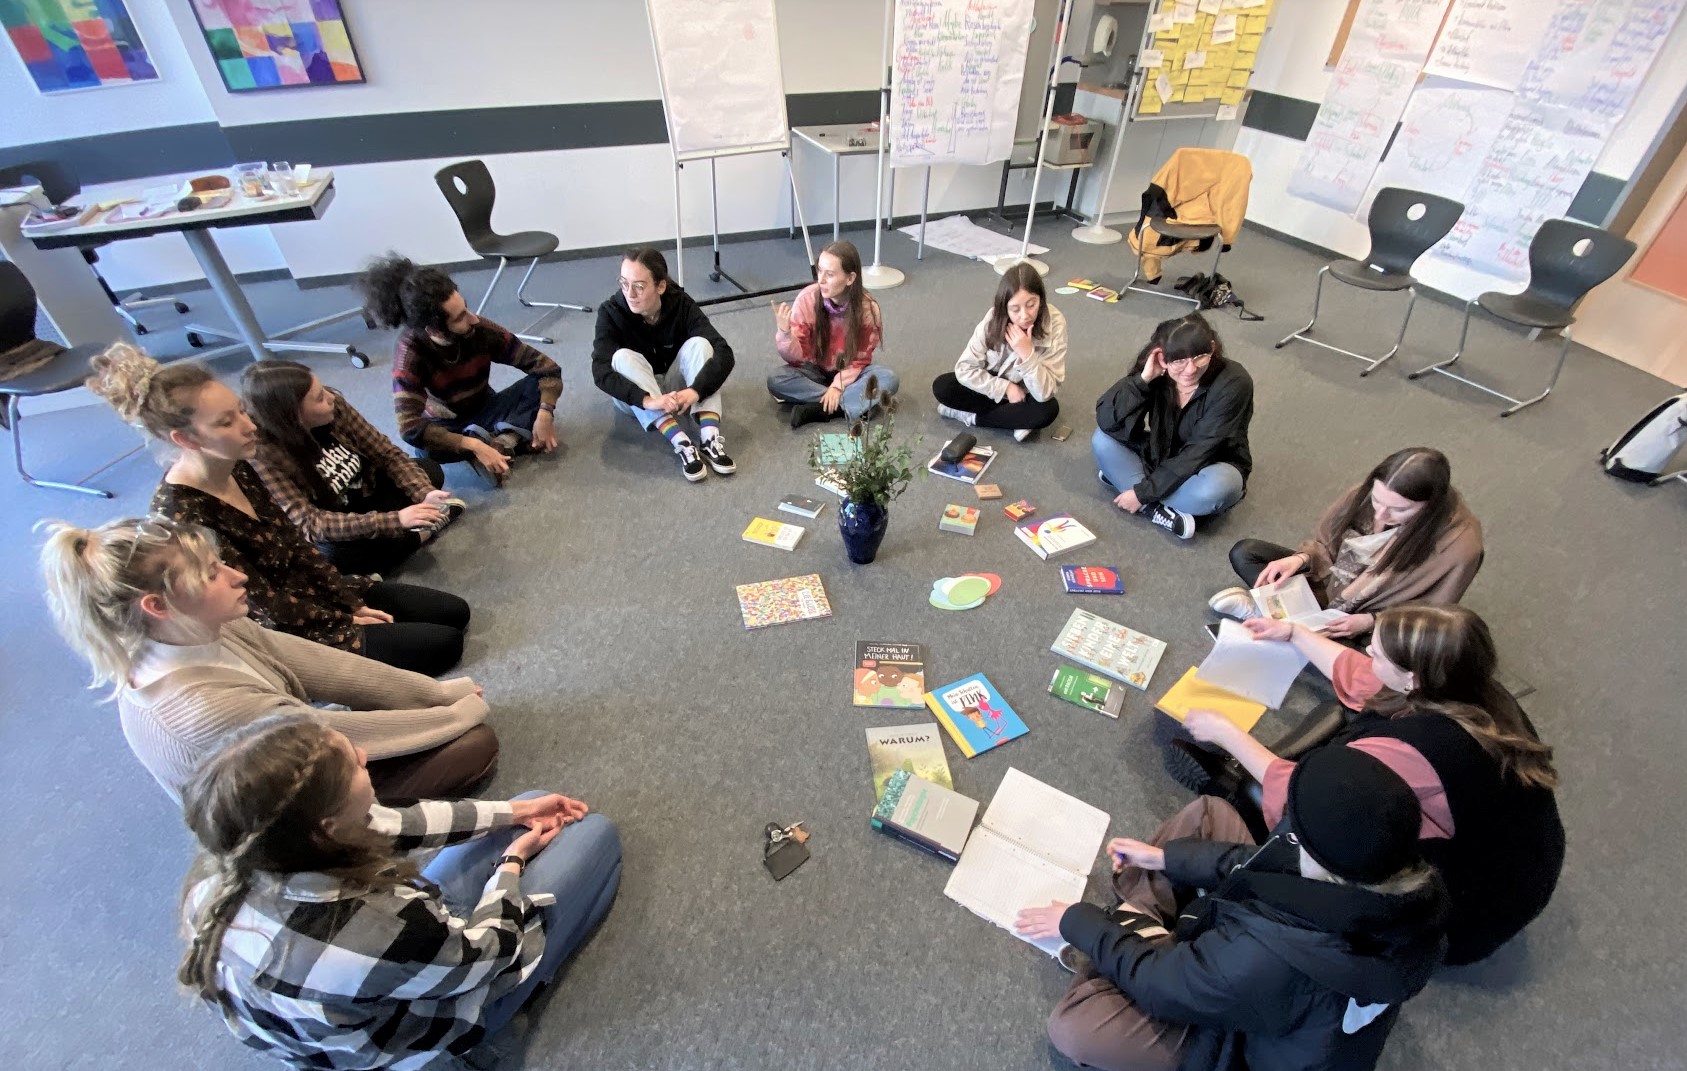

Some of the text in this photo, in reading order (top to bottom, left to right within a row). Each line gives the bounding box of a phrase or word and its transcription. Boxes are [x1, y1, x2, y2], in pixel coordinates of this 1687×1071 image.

[1061, 616, 1087, 647] SIEBEN
[1078, 621, 1105, 658] KINDER
[863, 652, 889, 660] MEINER
[1099, 633, 1121, 659] EINE
[1117, 639, 1140, 667] WELT
[959, 690, 988, 709] PINK
[879, 735, 930, 745] WARUM?
